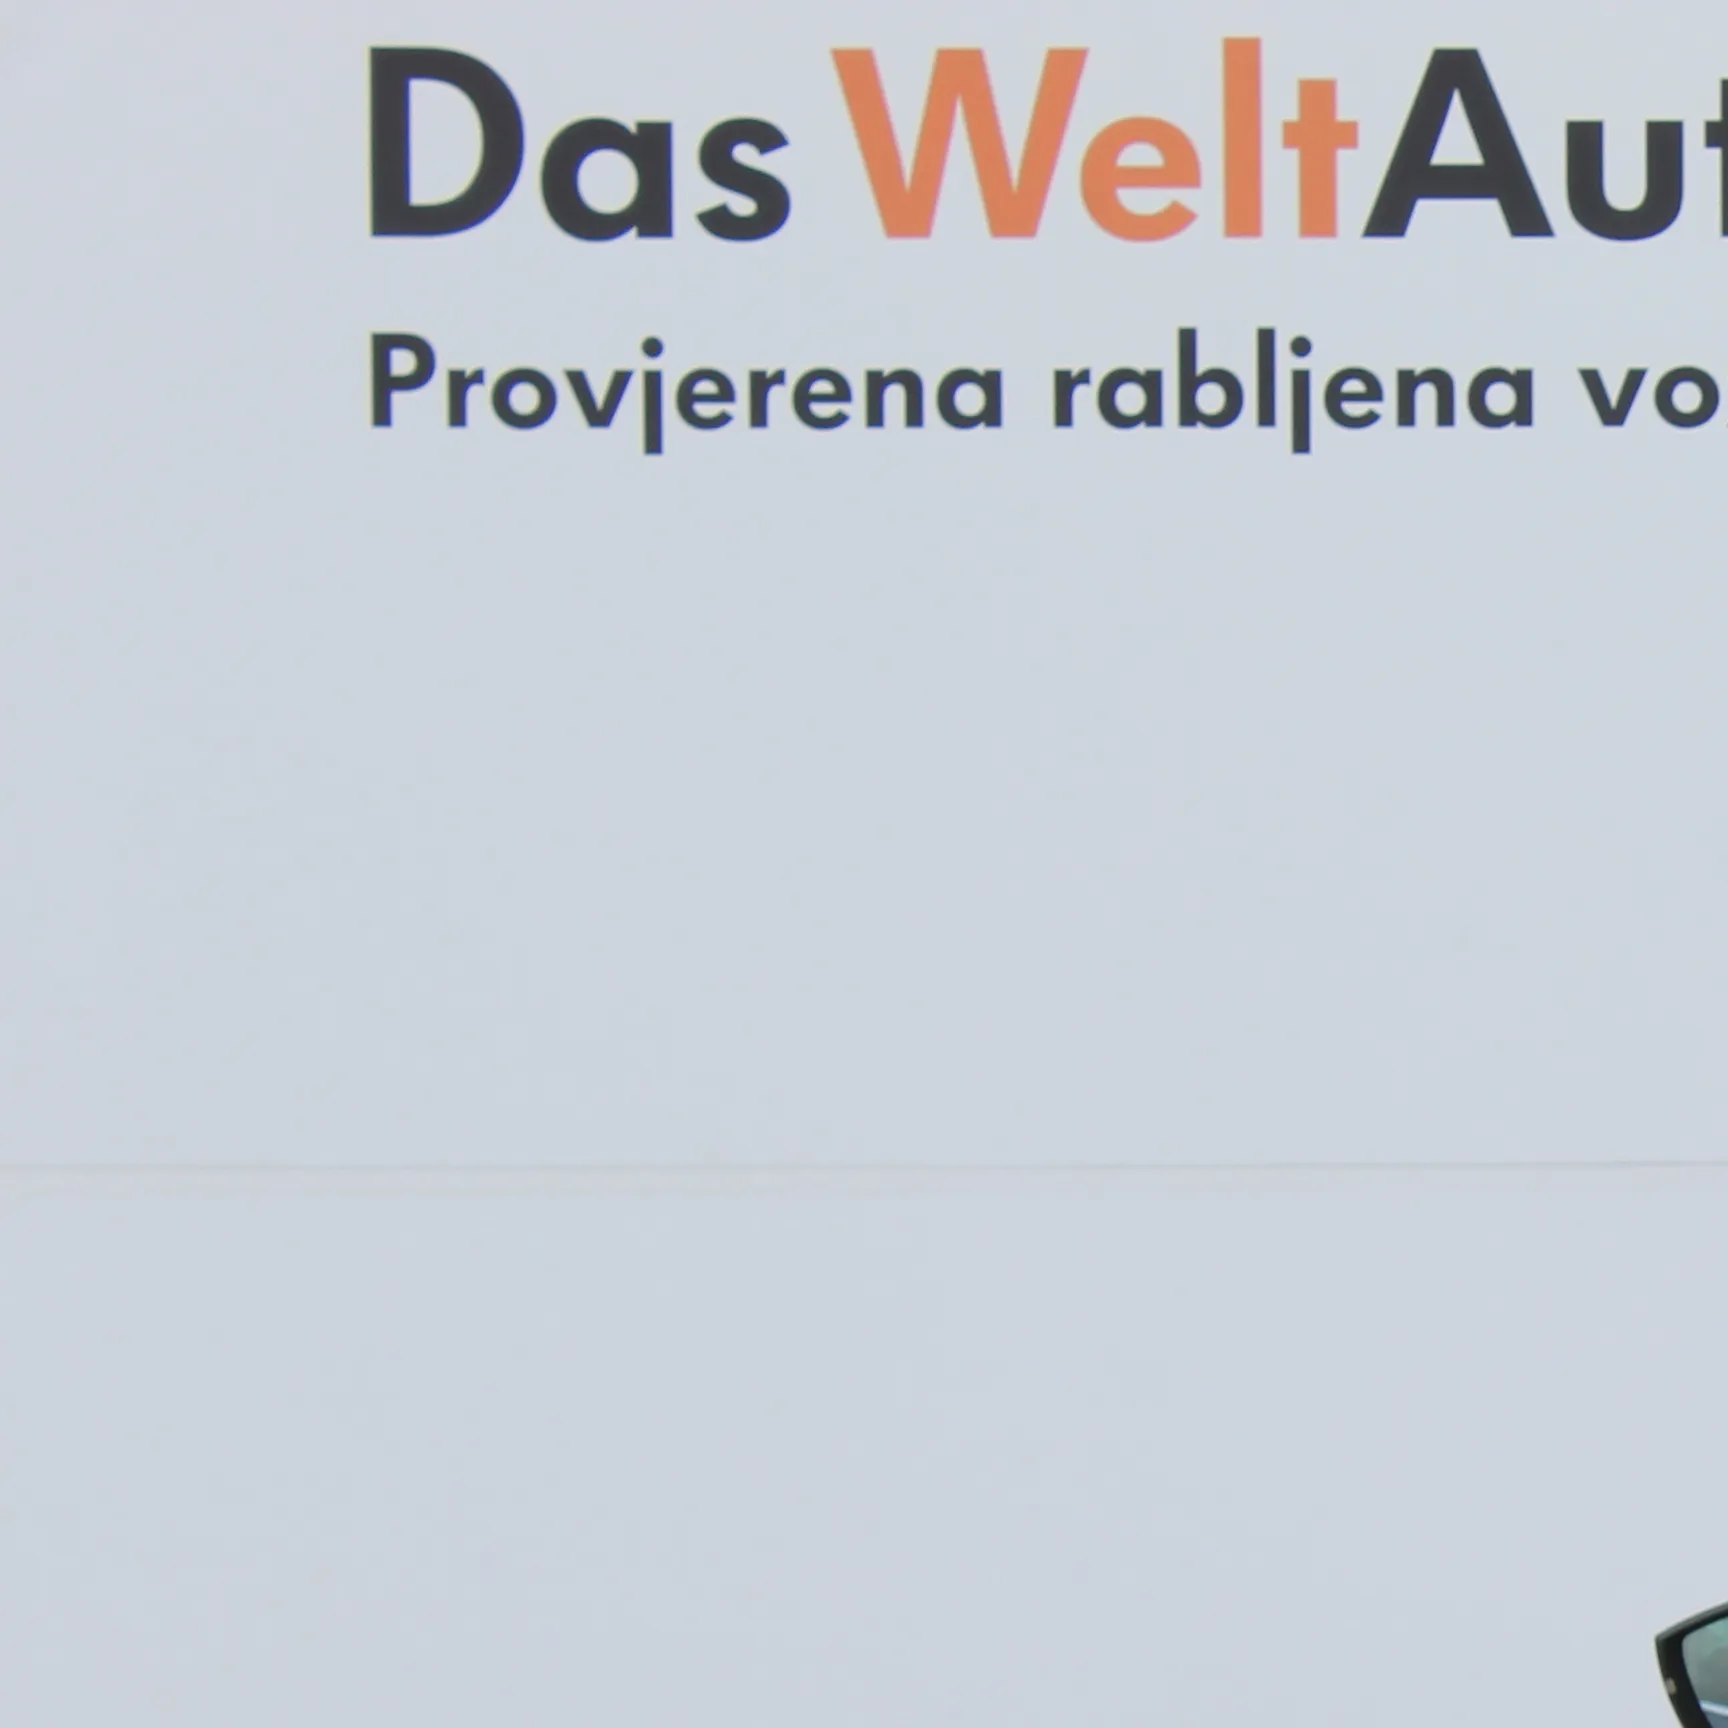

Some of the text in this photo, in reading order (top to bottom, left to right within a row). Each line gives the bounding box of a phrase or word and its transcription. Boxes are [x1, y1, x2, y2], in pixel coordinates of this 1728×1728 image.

[368, 45, 793, 244] Das
[369, 331, 1003, 457] Provjerena
[1052, 326, 1535, 456] rabljena
